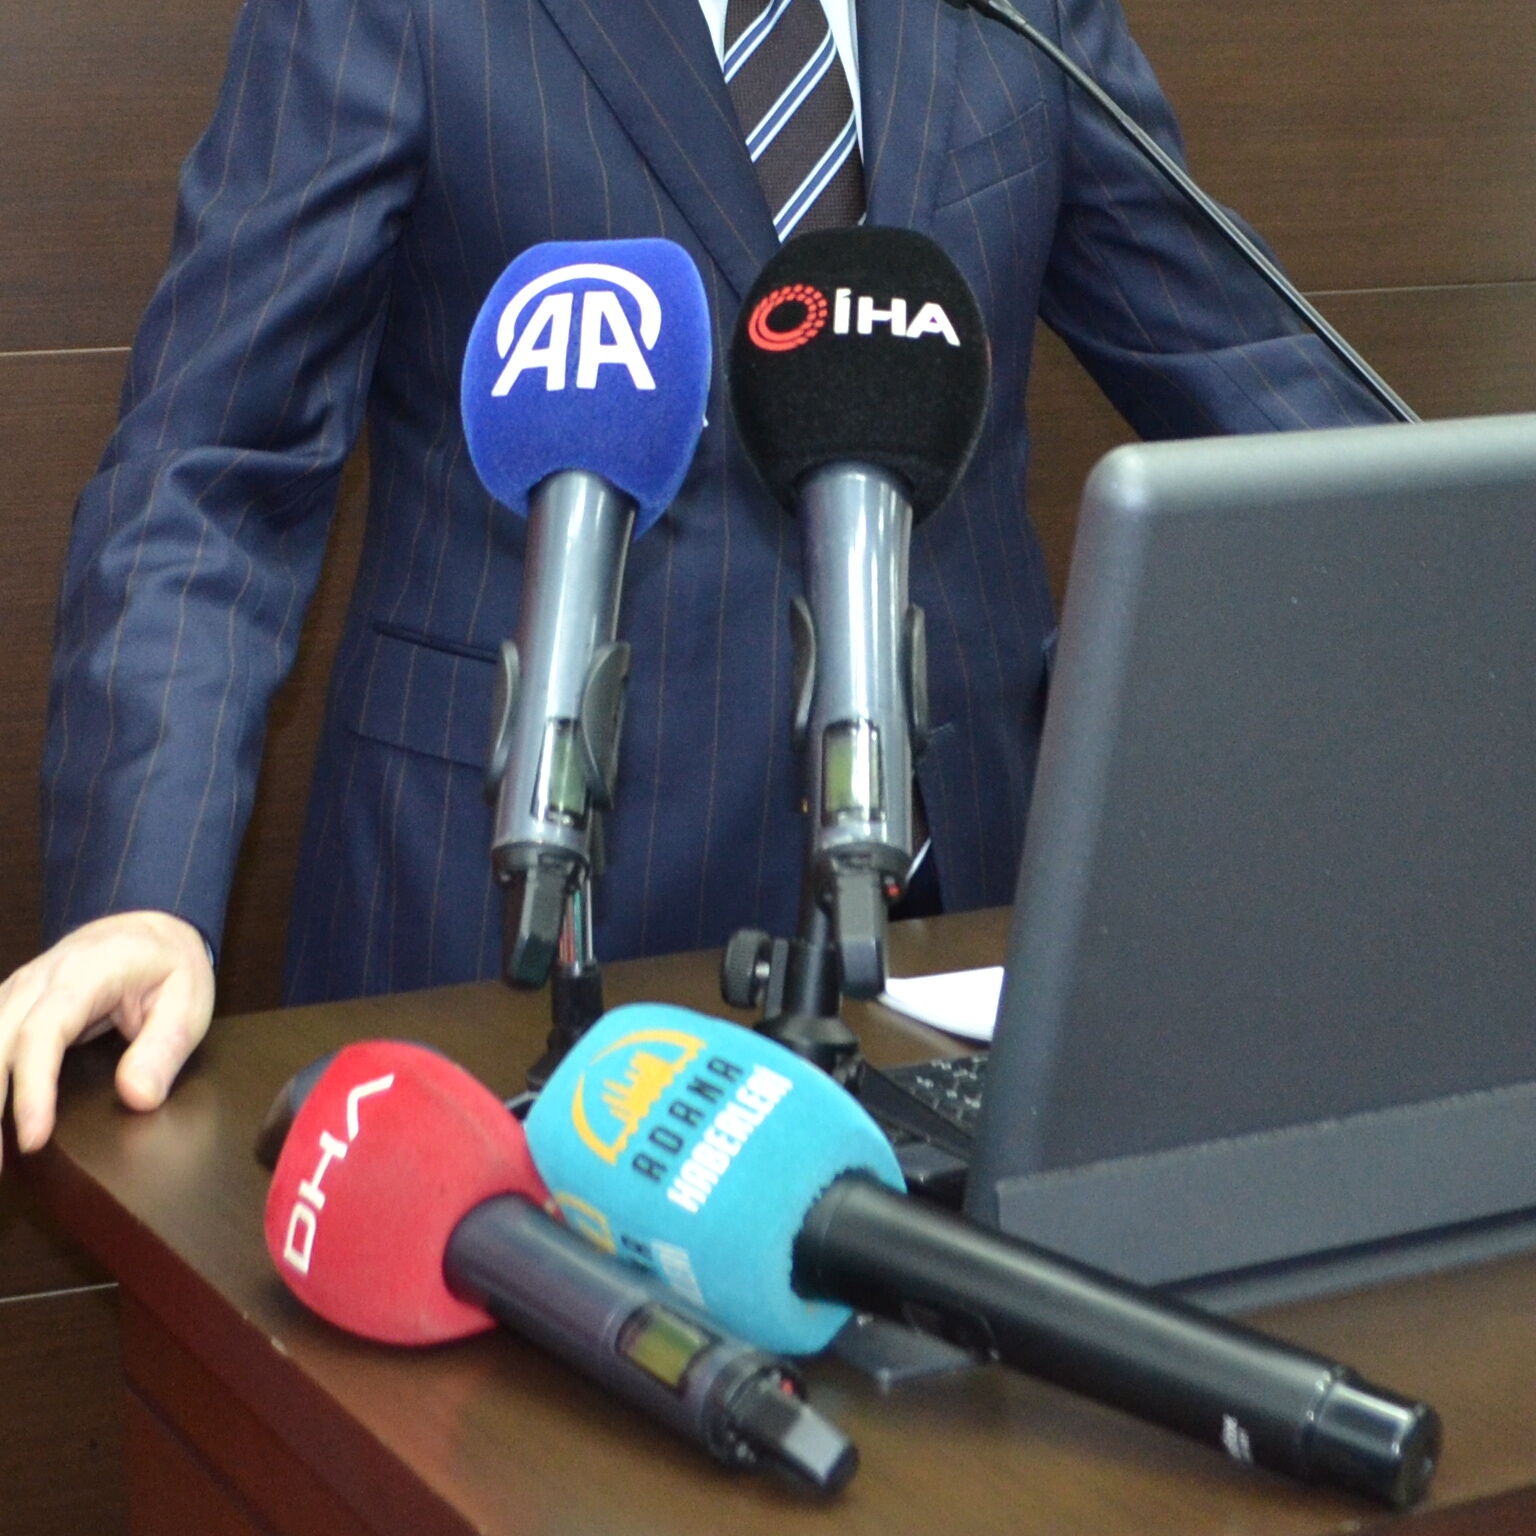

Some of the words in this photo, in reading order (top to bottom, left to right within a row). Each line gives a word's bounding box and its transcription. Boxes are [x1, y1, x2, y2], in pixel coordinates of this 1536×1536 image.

[491, 291, 655, 397] AA
[833, 288, 960, 347] İHA
[283, 1073, 395, 1275] DHA
[632, 1055, 745, 1185] ADANA
